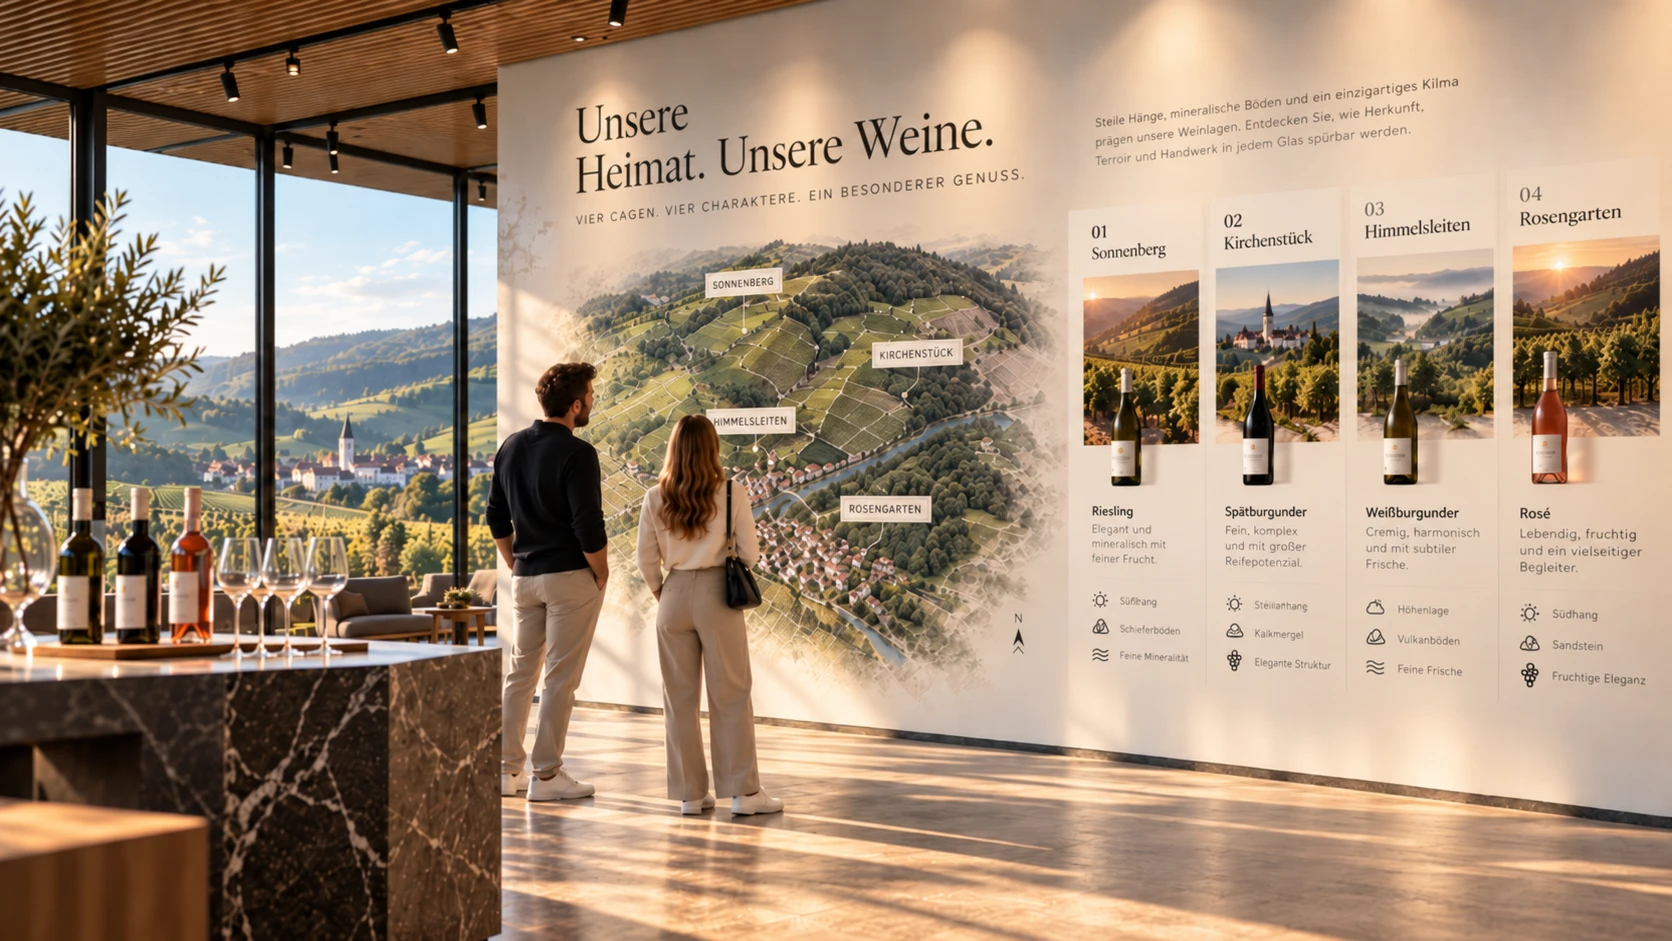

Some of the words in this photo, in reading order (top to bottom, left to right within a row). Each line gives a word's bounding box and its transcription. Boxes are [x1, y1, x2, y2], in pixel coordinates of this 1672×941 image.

[1096, 116, 1125, 127] Steile
[1129, 112, 1167, 124] Hänge,
[1170, 102, 1240, 119] mineralische
[1245, 98, 1281, 110] Böden
[1286, 93, 1308, 105] und
[1313, 91, 1331, 102] ein
[1335, 82, 1417, 101] einzigartiges
[1423, 78, 1458, 90] Kilma
[576, 104, 688, 144] Unsere
[1096, 136, 1133, 149] prägen
[1137, 131, 1174, 142] unsere
[1178, 124, 1241, 137] Weinlagen.
[1246, 116, 1308, 130] Entdecken
[1313, 112, 1334, 123] Sie,
[1339, 108, 1360, 119] wie
[1365, 102, 1424, 117] Herkunft,
[1095, 153, 1131, 165] Terroir
[1135, 150, 1156, 162] und
[1161, 144, 1218, 159] Handwerk
[1223, 142, 1232, 153] in
[1236, 140, 1272, 154] jedem
[1277, 136, 1304, 147] Glas
[1308, 131, 1355, 146] spürbar
[1360, 125, 1411, 138] werden.
[576, 150, 704, 194] Heimat.
[718, 136, 842, 176] Unsere
[854, 113, 993, 159] Weine.
[576, 213, 603, 225] VIER
[610, 208, 658, 222] CAGEN.
[665, 203, 694, 216] VIER
[702, 192, 800, 212] CHARAKTERE.
[809, 189, 832, 201] EIN
[841, 177, 944, 198] BESONDERER
[953, 169, 1024, 186] GENUSS.
[1520, 186, 1542, 202] 04
[1365, 202, 1384, 217] 03
[1224, 214, 1242, 228] 02
[1520, 206, 1622, 227] Rosengarten
[1092, 225, 1106, 239] 01
[1365, 217, 1470, 239] Himmelsleiten
[1225, 229, 1312, 250] Kirchenstück
[1092, 242, 1166, 260] Sonnenberg
[713, 276, 774, 290] SONNENBERG
[880, 346, 954, 360] KIRCHENSTÜCK
[714, 416, 787, 426] HIMMELSLEITEN
[849, 504, 921, 514] ROSENGARTEN
[1092, 506, 1133, 519] Riesling
[1225, 506, 1307, 520] Spätburgunder
[1366, 507, 1459, 521] Weißburgunder
[1520, 508, 1550, 519] Rosé
[1092, 524, 1129, 536] Elegant
[1132, 525, 1151, 534] und
[1226, 525, 1250, 536] Fein,
[1254, 526, 1297, 537] komplex
[1366, 526, 1409, 540] Cremig,
[1414, 527, 1479, 538] harmonisch
[1520, 528, 1581, 542] Lebendig,
[1586, 528, 1636, 542] fruchtig
[1092, 539, 1147, 549] mineralisch
[1150, 540, 1166, 549] mit
[1226, 541, 1245, 550] und
[1249, 541, 1265, 551] mit
[1270, 541, 1306, 553] großer
[1366, 543, 1387, 553] und
[1391, 543, 1409, 553] mit
[1413, 543, 1456, 554] subtiler
[1092, 553, 1120, 563] feiner
[1123, 554, 1157, 564] Frucht.
[1520, 545, 1543, 556] und
[1548, 546, 1566, 556] ein
[1571, 546, 1642, 559] vielseitiger
[1226, 556, 1302, 568] Reifepotenzial.
[1366, 559, 1408, 569] Frische.
[1520, 562, 1578, 575] Begleiter.
[1015, 613, 1022, 623] N
[1398, 605, 1449, 618] Höhenlage
[1552, 609, 1598, 622] Südhang
[1255, 629, 1303, 641] Kalkmergel
[1397, 635, 1460, 645] Vulkanböden
[1553, 640, 1603, 651] Sandstein
[1120, 651, 1142, 660] Feine
[1144, 653, 1189, 662] Mineralität
[1255, 657, 1292, 669] Elegante
[1295, 659, 1331, 670] Struktur
[1398, 664, 1423, 674] Feine
[1427, 666, 1462, 676] Frische
[1552, 671, 1600, 685] Fruchtige
[1604, 673, 1645, 687] Eleganz
